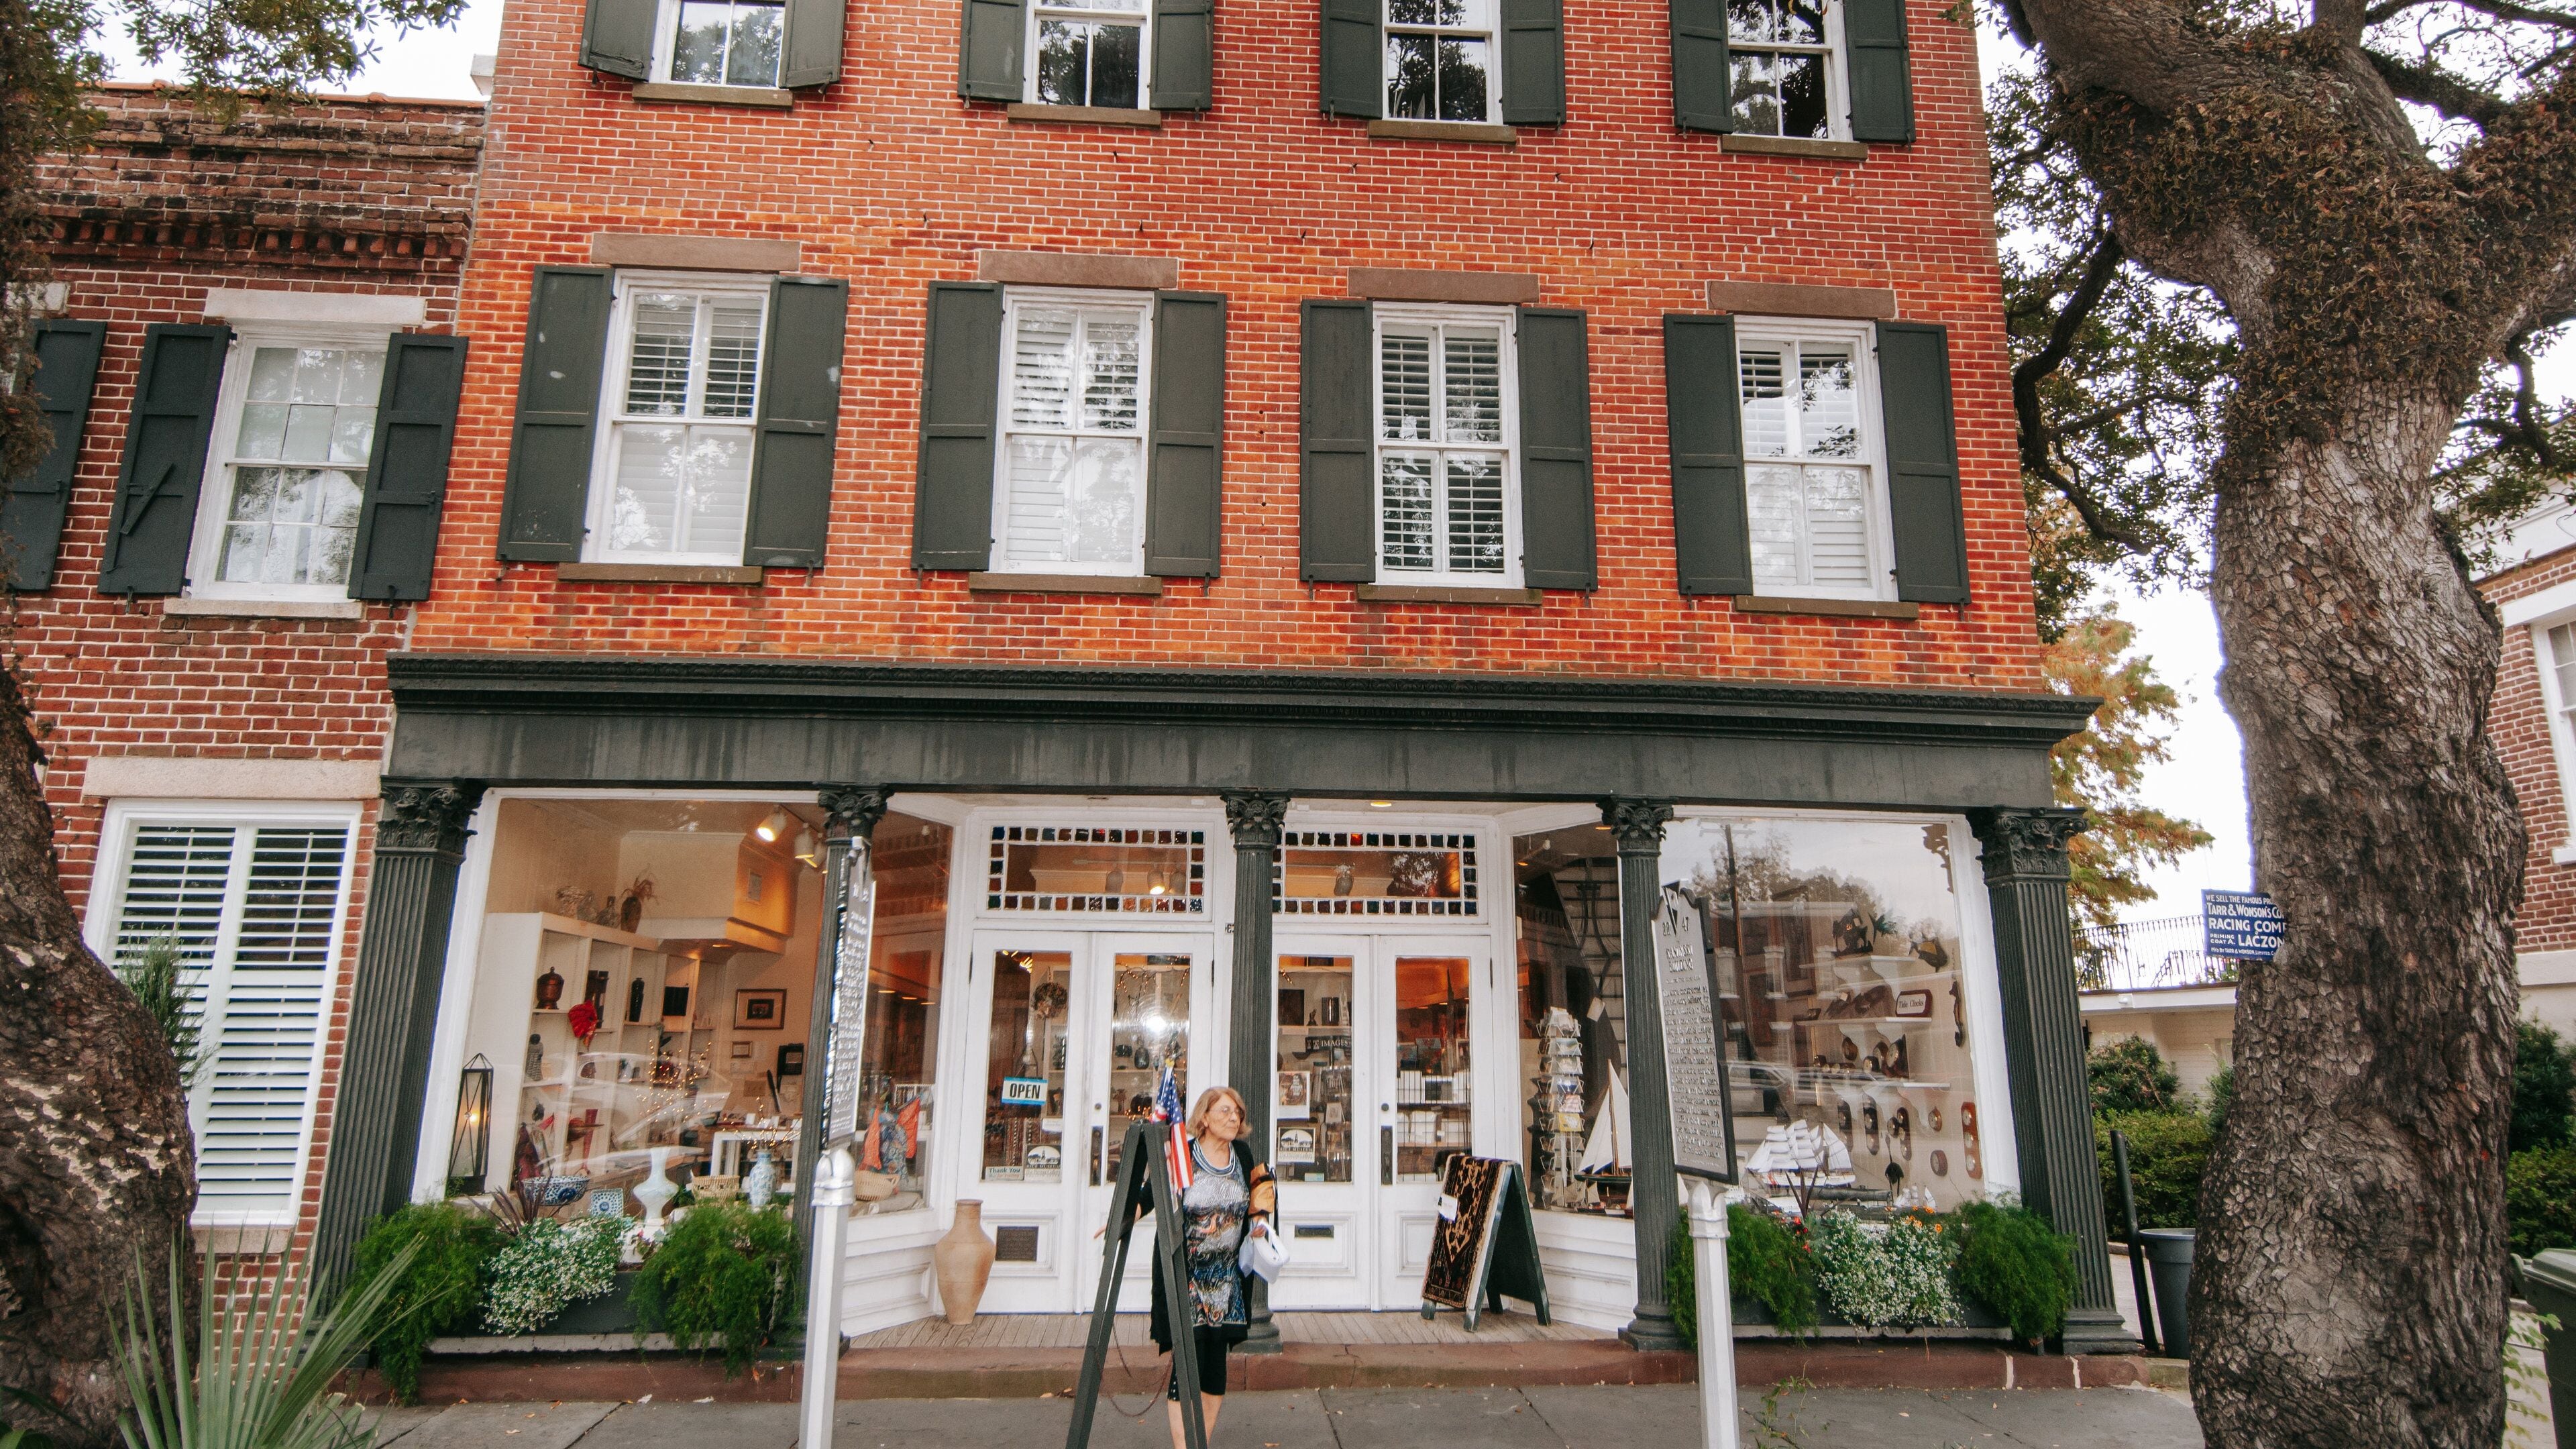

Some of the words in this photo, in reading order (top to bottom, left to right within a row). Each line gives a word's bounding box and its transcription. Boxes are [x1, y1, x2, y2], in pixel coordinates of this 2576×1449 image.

[2242, 896, 2262, 904] FAMOUS
[2206, 902, 2227, 916] TARR
[2228, 904, 2237, 916] &
[2236, 904, 2271, 918] WONSON'S
[1663, 921, 1670, 936] 22
[1682, 916, 1689, 932] 47
[2208, 918, 2251, 931] RACING
[1909, 999, 1924, 1008] Clocks
[1321, 1038, 1348, 1047] IMAGES
[1010, 1083, 1040, 1099] OPEN
